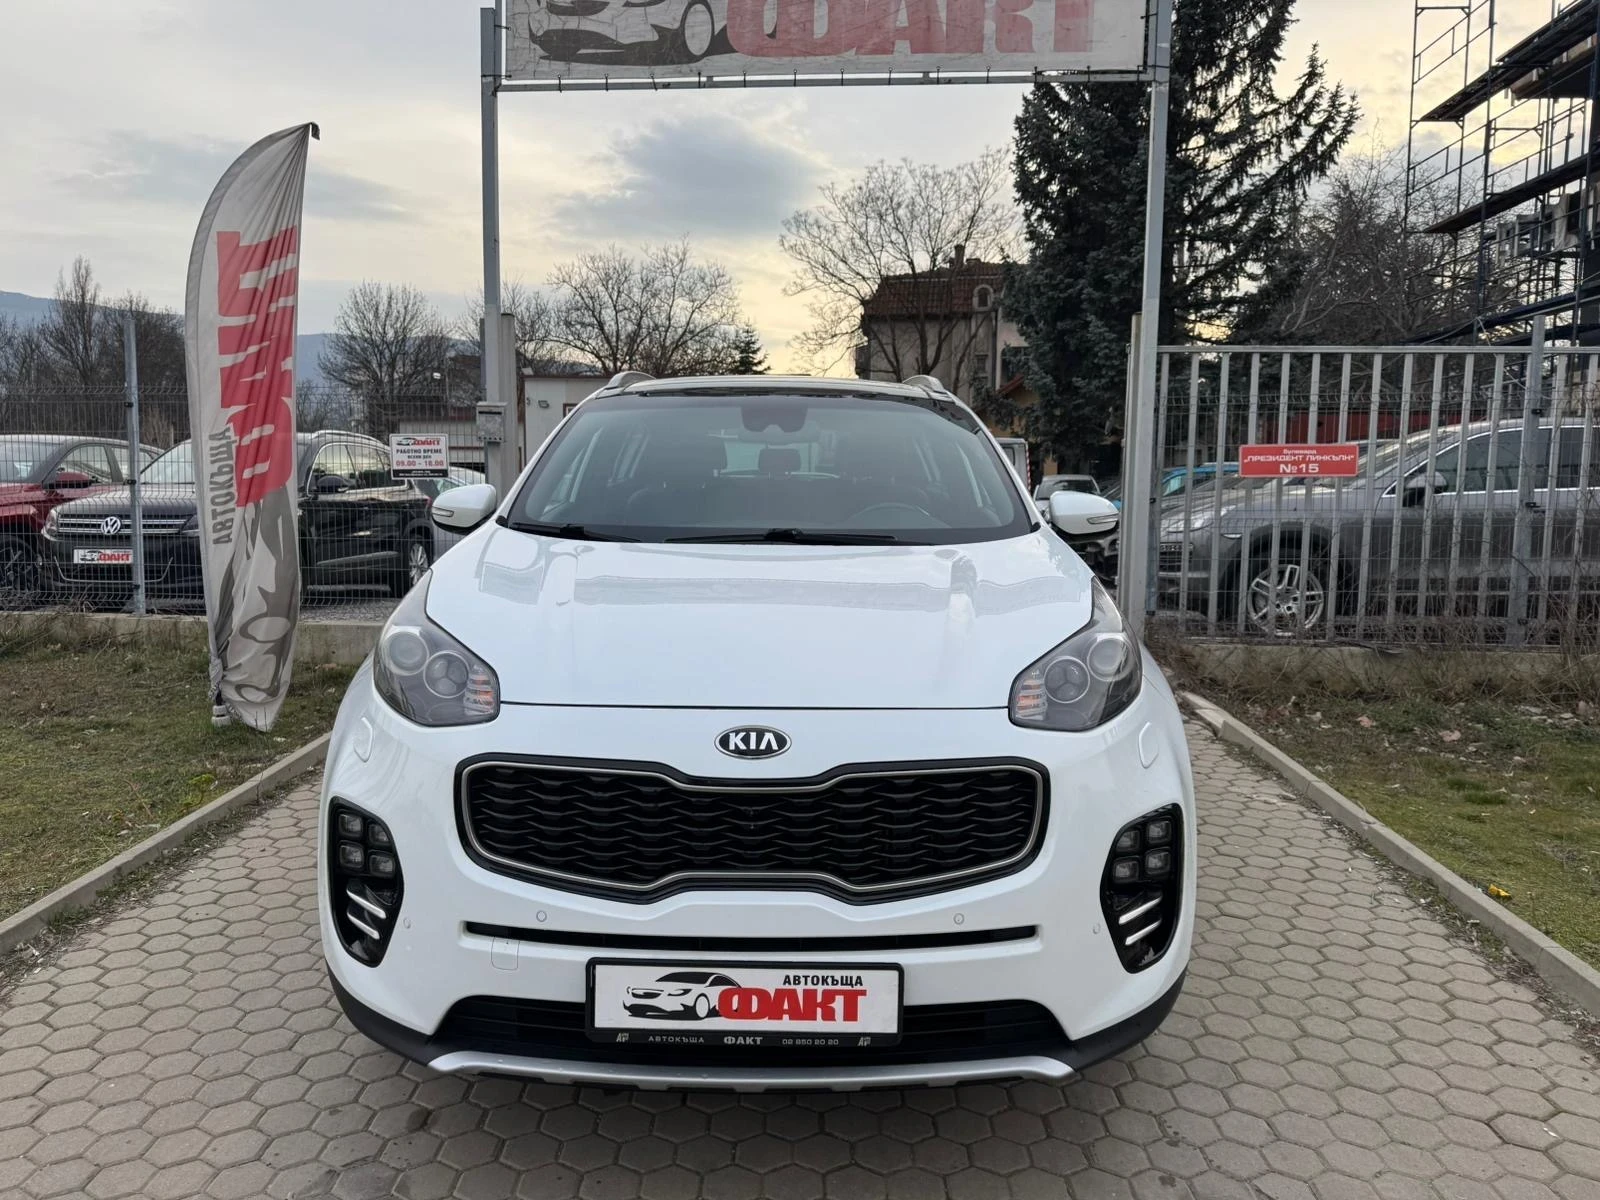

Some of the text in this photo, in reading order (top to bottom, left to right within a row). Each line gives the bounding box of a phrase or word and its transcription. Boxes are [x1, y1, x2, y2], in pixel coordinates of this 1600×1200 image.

[216, 225, 297, 507] ФАКТ
[208, 426, 239, 546] АВТОКЪЩА
[728, 732, 779, 751] KIA
[783, 974, 863, 988] АВТОКЪЩА
[717, 987, 867, 1022] ФАКТ
[723, 1036, 763, 1045] ФАКТ
